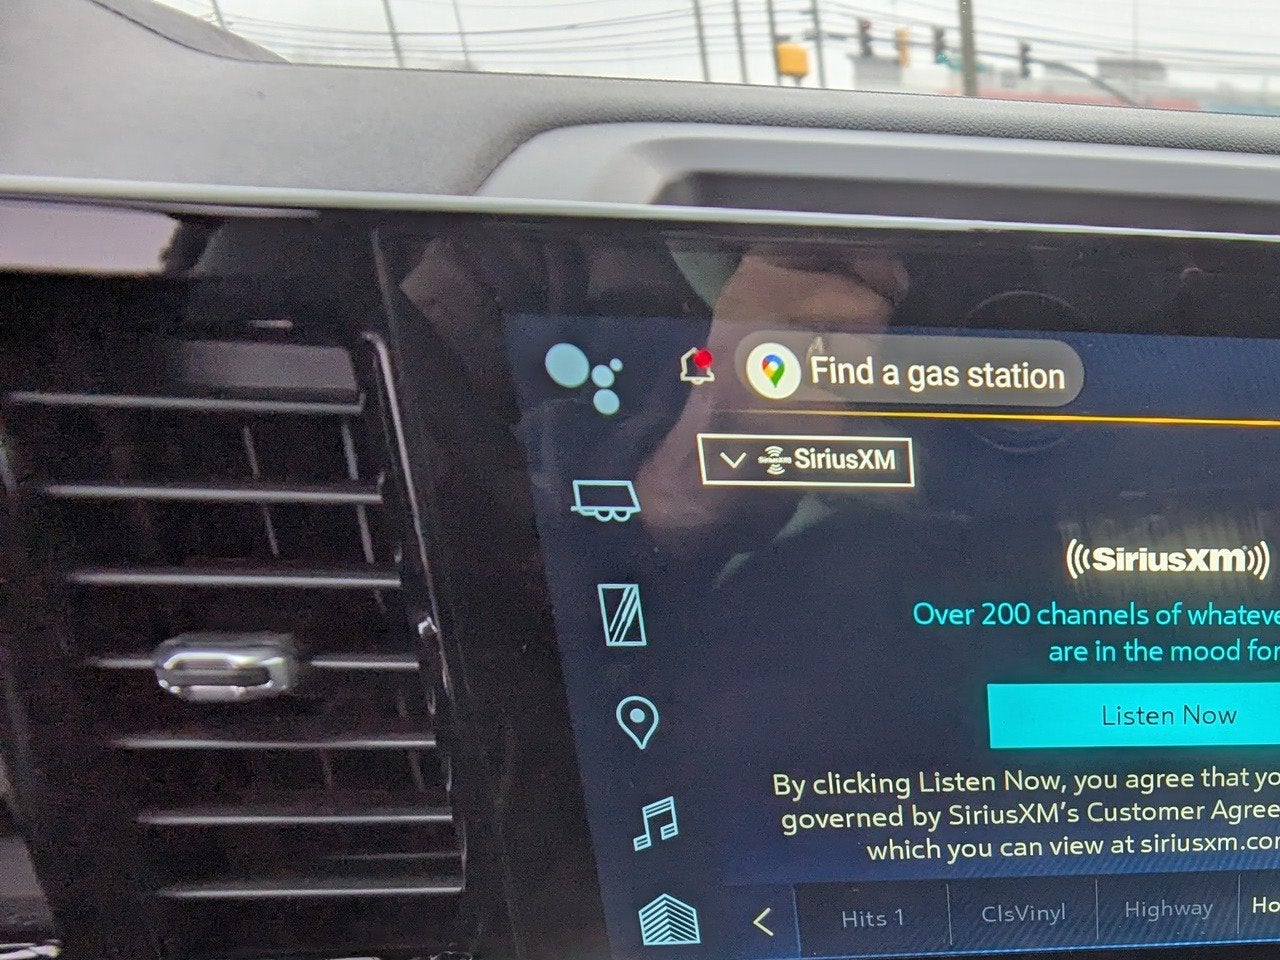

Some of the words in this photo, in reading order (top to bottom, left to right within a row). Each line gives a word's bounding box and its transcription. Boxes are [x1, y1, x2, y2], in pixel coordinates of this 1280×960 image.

[811, 355, 872, 386] Find
[883, 364, 900, 385] a
[908, 364, 960, 392] gas
[968, 362, 1065, 389] station
[795, 448, 897, 470] SiriusXM
[913, 601, 975, 625] Over
[981, 602, 1031, 625] 200
[1037, 600, 1149, 625] channels
[1156, 601, 1183, 625] of
[1049, 644, 1088, 662] are
[1095, 639, 1116, 661] in
[1124, 638, 1162, 661] the
[1171, 638, 1241, 661] mood
[1102, 705, 1174, 726] Listen
[1183, 704, 1238, 725] Now
[773, 773, 806, 801] By
[813, 771, 911, 799] clicking
[919, 771, 995, 793] Listen
[1004, 769, 1067, 793] Now,
[1073, 772, 1118, 796] you
[1125, 768, 1194, 794] agree
[1201, 766, 1250, 788] that
[781, 804, 903, 836] governed
[912, 804, 942, 832] by
[1087, 799, 1206, 823] Customer
[866, 837, 941, 862] which
[947, 841, 993, 865] you
[1000, 838, 1043, 858] can
[1049, 835, 1104, 856] view
[1111, 834, 1135, 855] at
[841, 909, 887, 928] Hits
[894, 909, 904, 925] 1
[981, 903, 1067, 925] ClsVinyl
[1125, 899, 1214, 922] Highway
